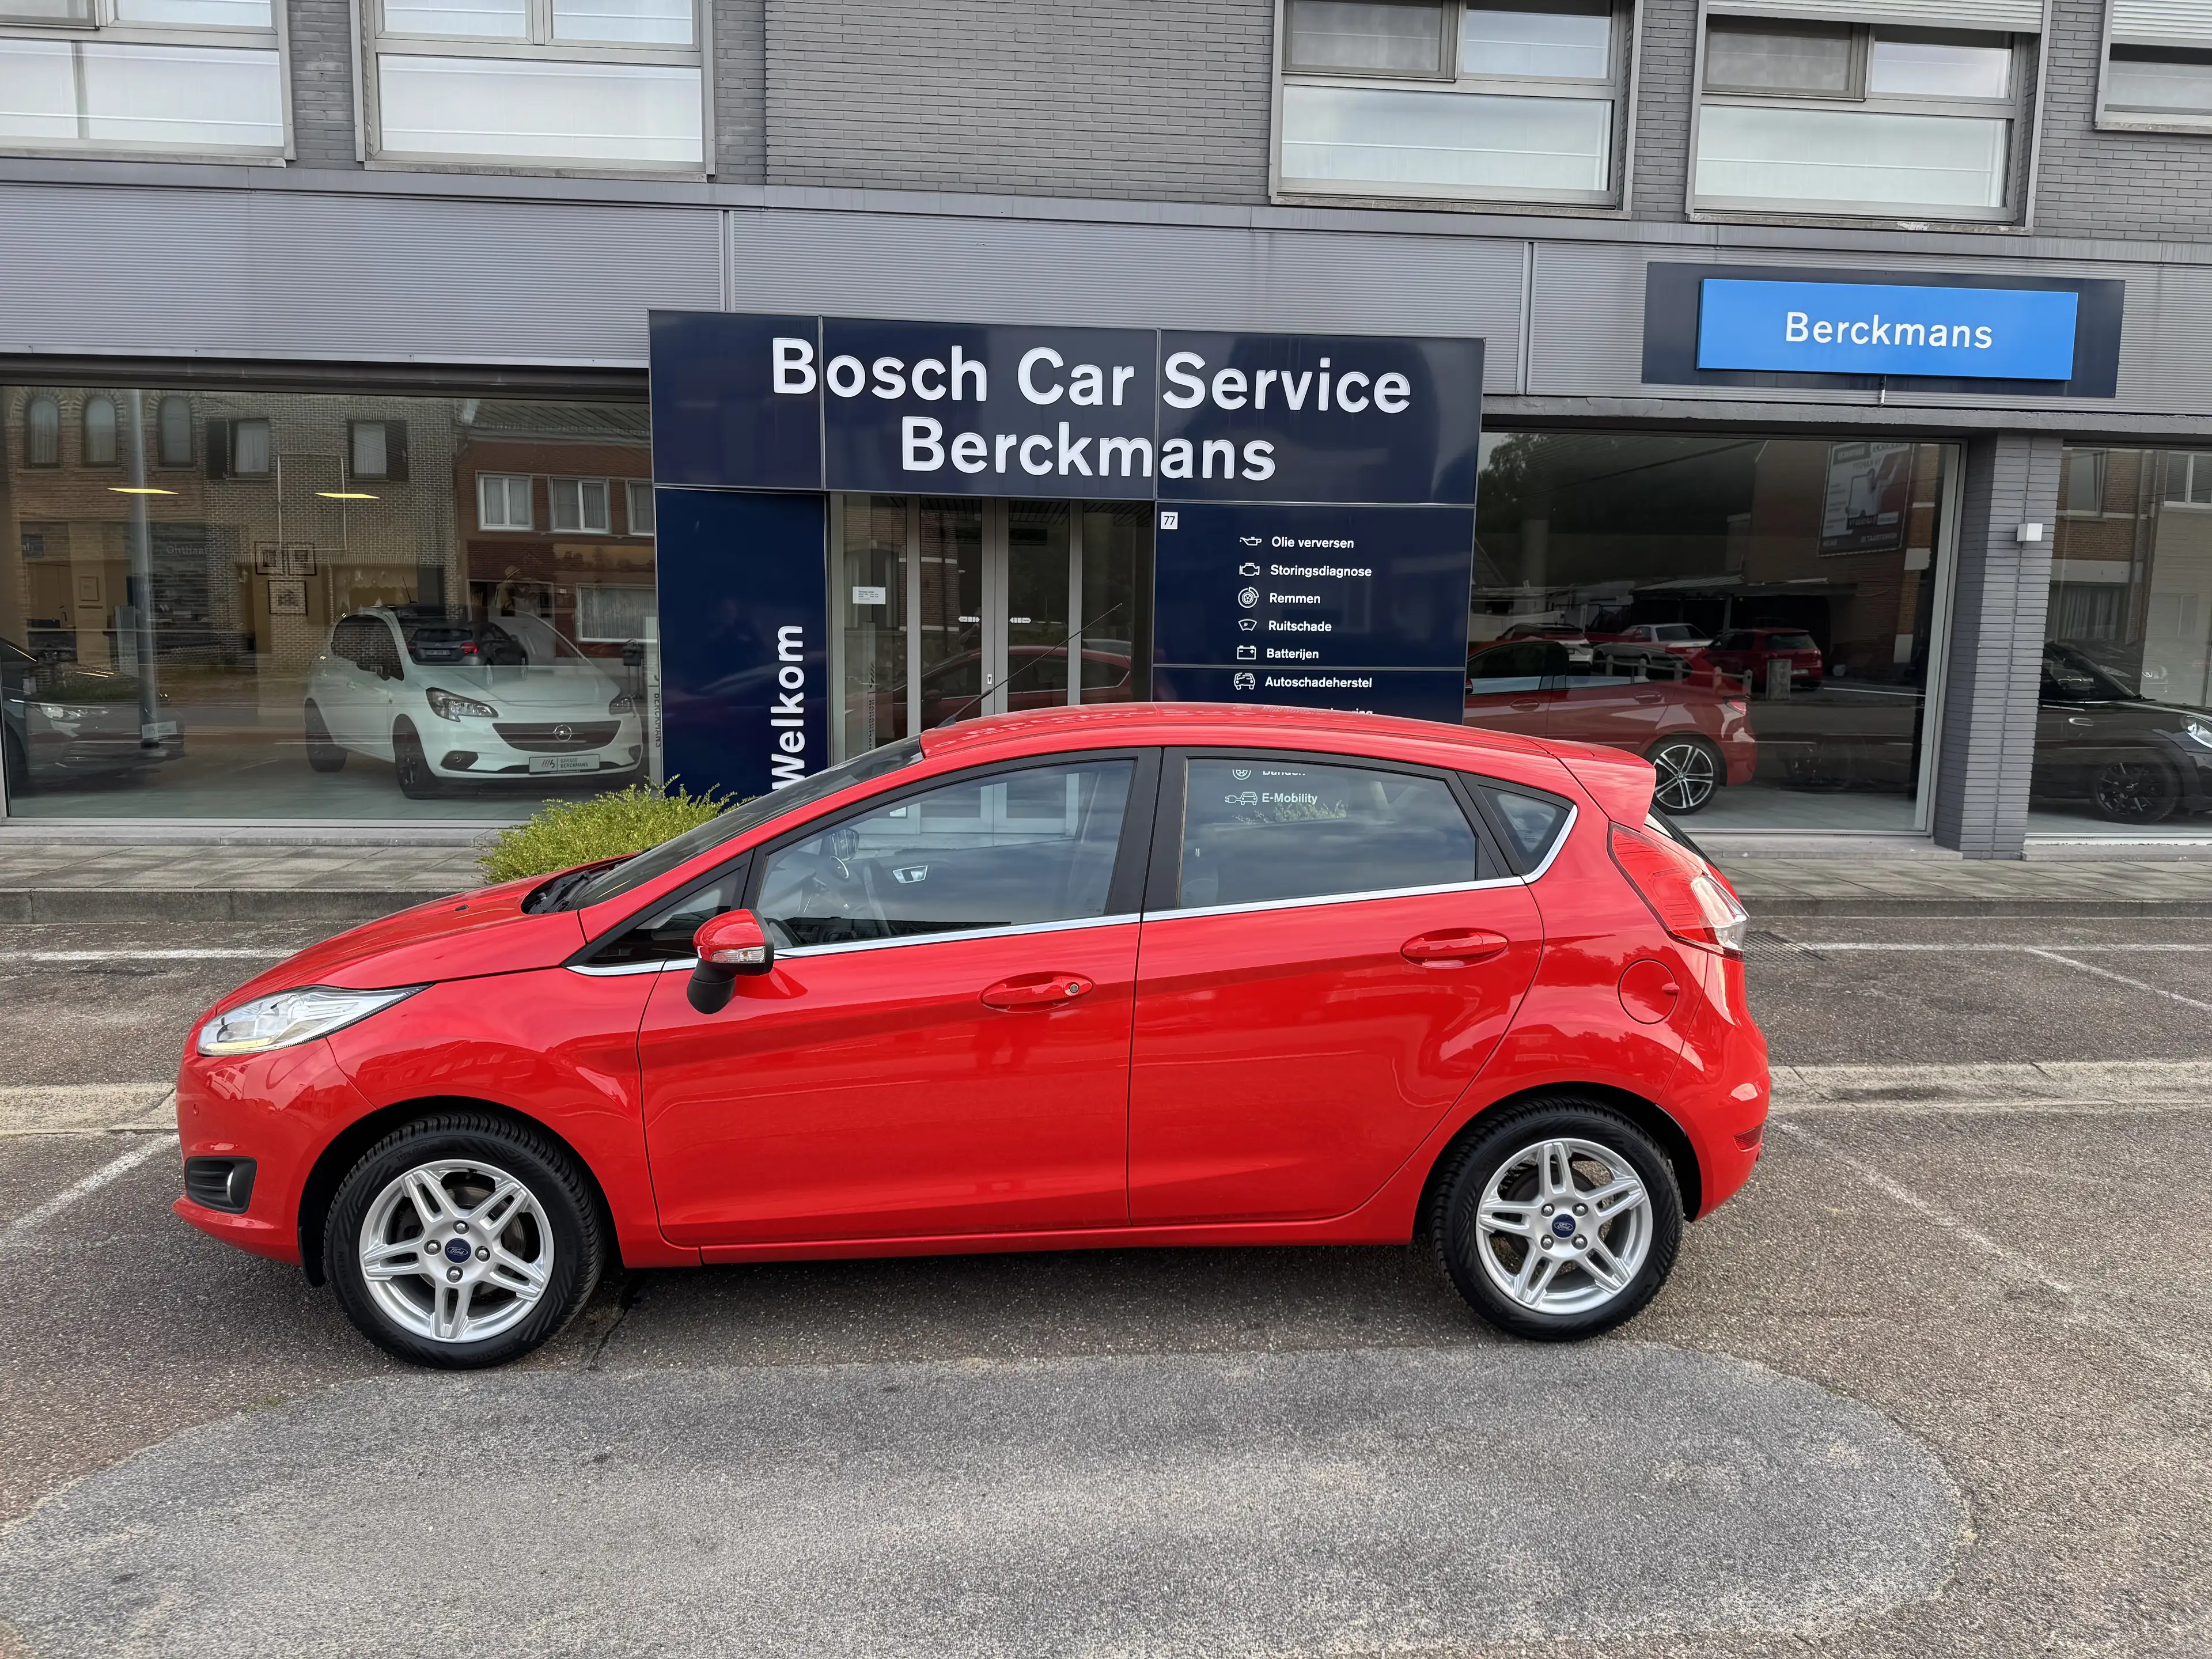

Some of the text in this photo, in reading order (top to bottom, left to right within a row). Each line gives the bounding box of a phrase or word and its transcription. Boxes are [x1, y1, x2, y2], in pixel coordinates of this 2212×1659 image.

[1786, 312, 1992, 349] Berckmans
[772, 338, 1411, 414] Bosch Car Service
[902, 416, 1275, 481] Berckmans
[1164, 516, 1176, 525] 77
[1271, 536, 1354, 548] Olie verversen
[1270, 565, 1372, 578] Storingsdiagnose
[1269, 593, 1321, 604] Remmen
[1268, 620, 1332, 632] Ruitschade
[1267, 648, 1319, 661] Batterijen
[1264, 676, 1372, 688] Autoschadeherstel
[770, 626, 805, 790] Welkom
[1262, 792, 1318, 805] E-Mobility
